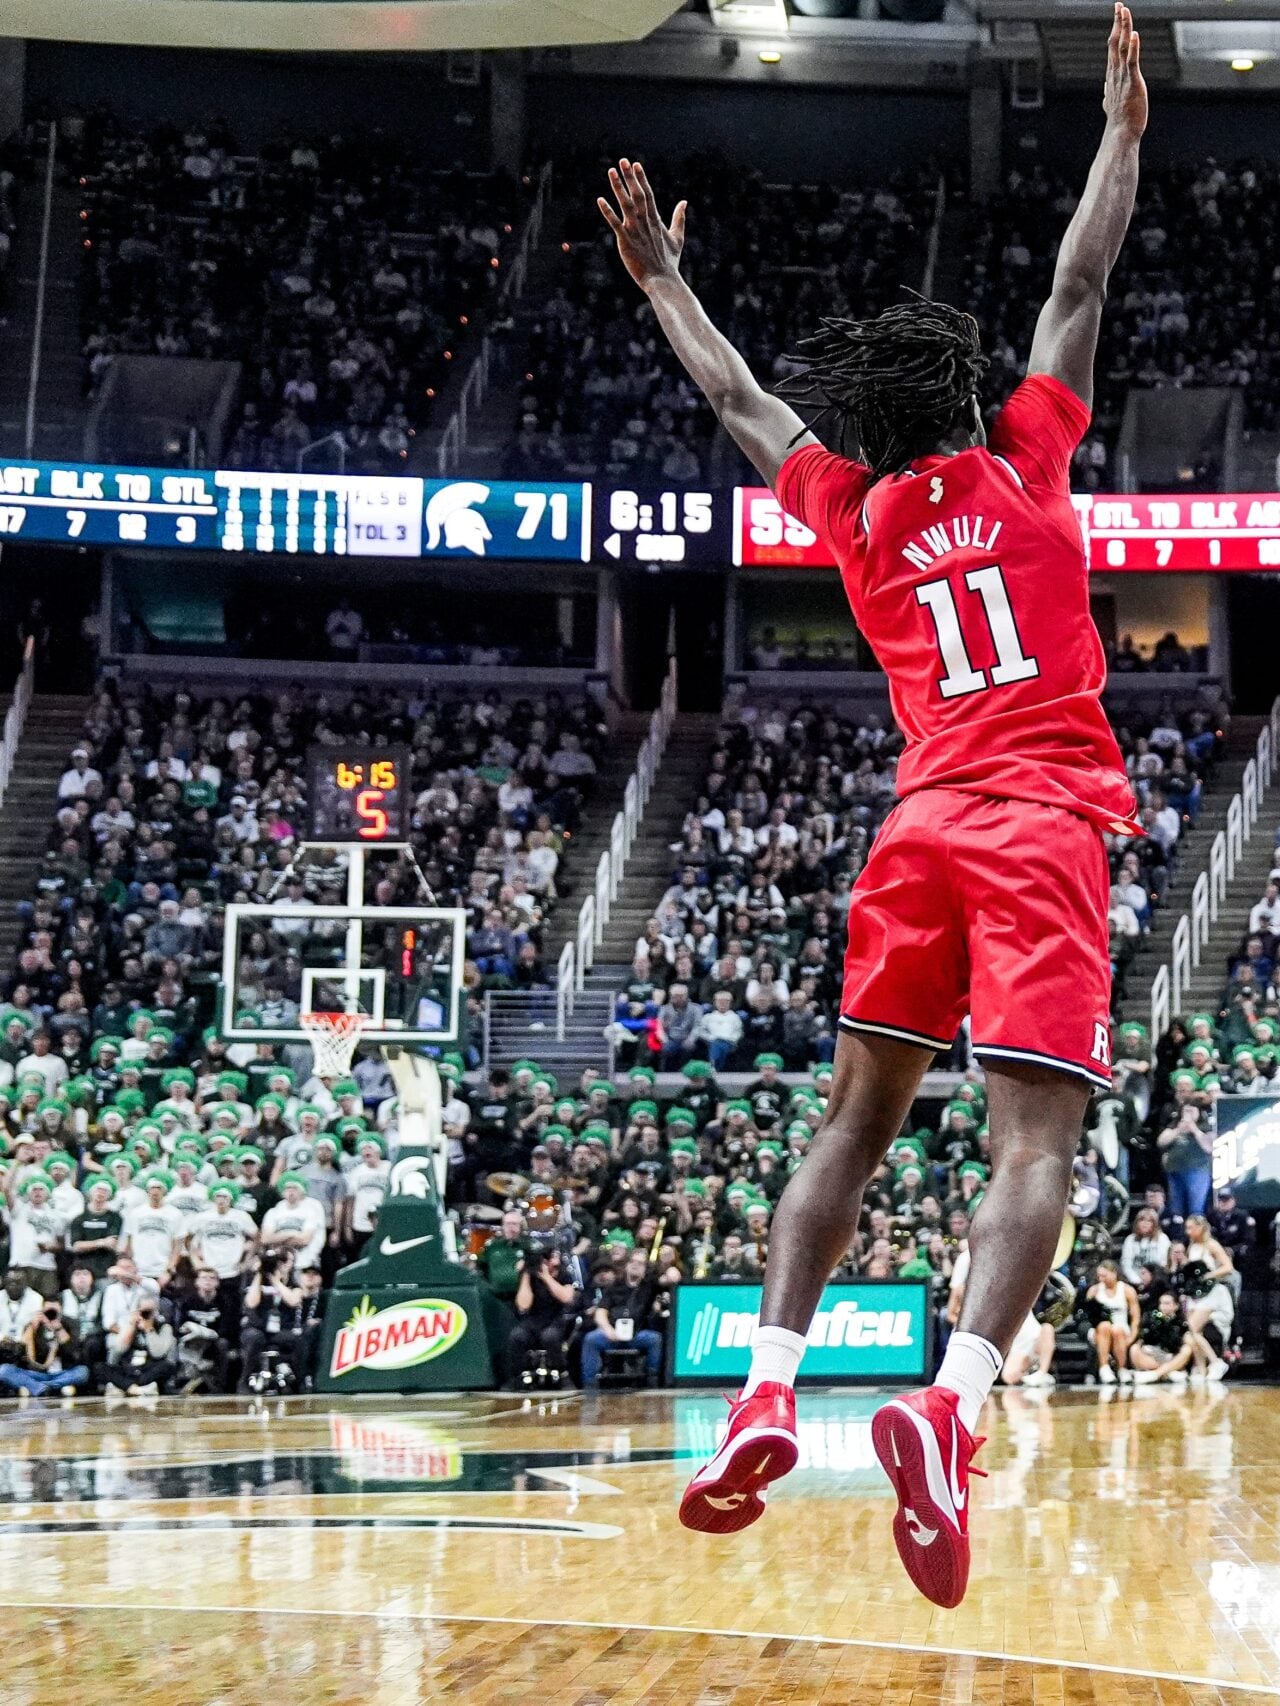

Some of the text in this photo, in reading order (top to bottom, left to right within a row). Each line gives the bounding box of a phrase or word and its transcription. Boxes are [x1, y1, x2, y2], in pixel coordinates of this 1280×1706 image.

[51, 470, 104, 499] BLK
[115, 473, 151, 501] TO
[162, 476, 213, 505] STL
[66, 510, 86, 537] 7
[175, 516, 196, 543] 3
[354, 524, 407, 541] TOL 3
[514, 492, 568, 540] 71
[610, 491, 712, 533] 6:15
[1094, 502, 1140, 529] STL
[1148, 502, 1180, 528] TO
[1191, 501, 1238, 528] BLK
[902, 515, 1003, 571] NWULI
[1155, 539, 1173, 566] 7
[915, 565, 1040, 699] 11
[337, 761, 396, 790] 6:15
[356, 790, 388, 838] 5
[1090, 1021, 1110, 1068] R
[335, 1310, 453, 1371] LIBMAN
[716, 1301, 914, 1347] mufcu
